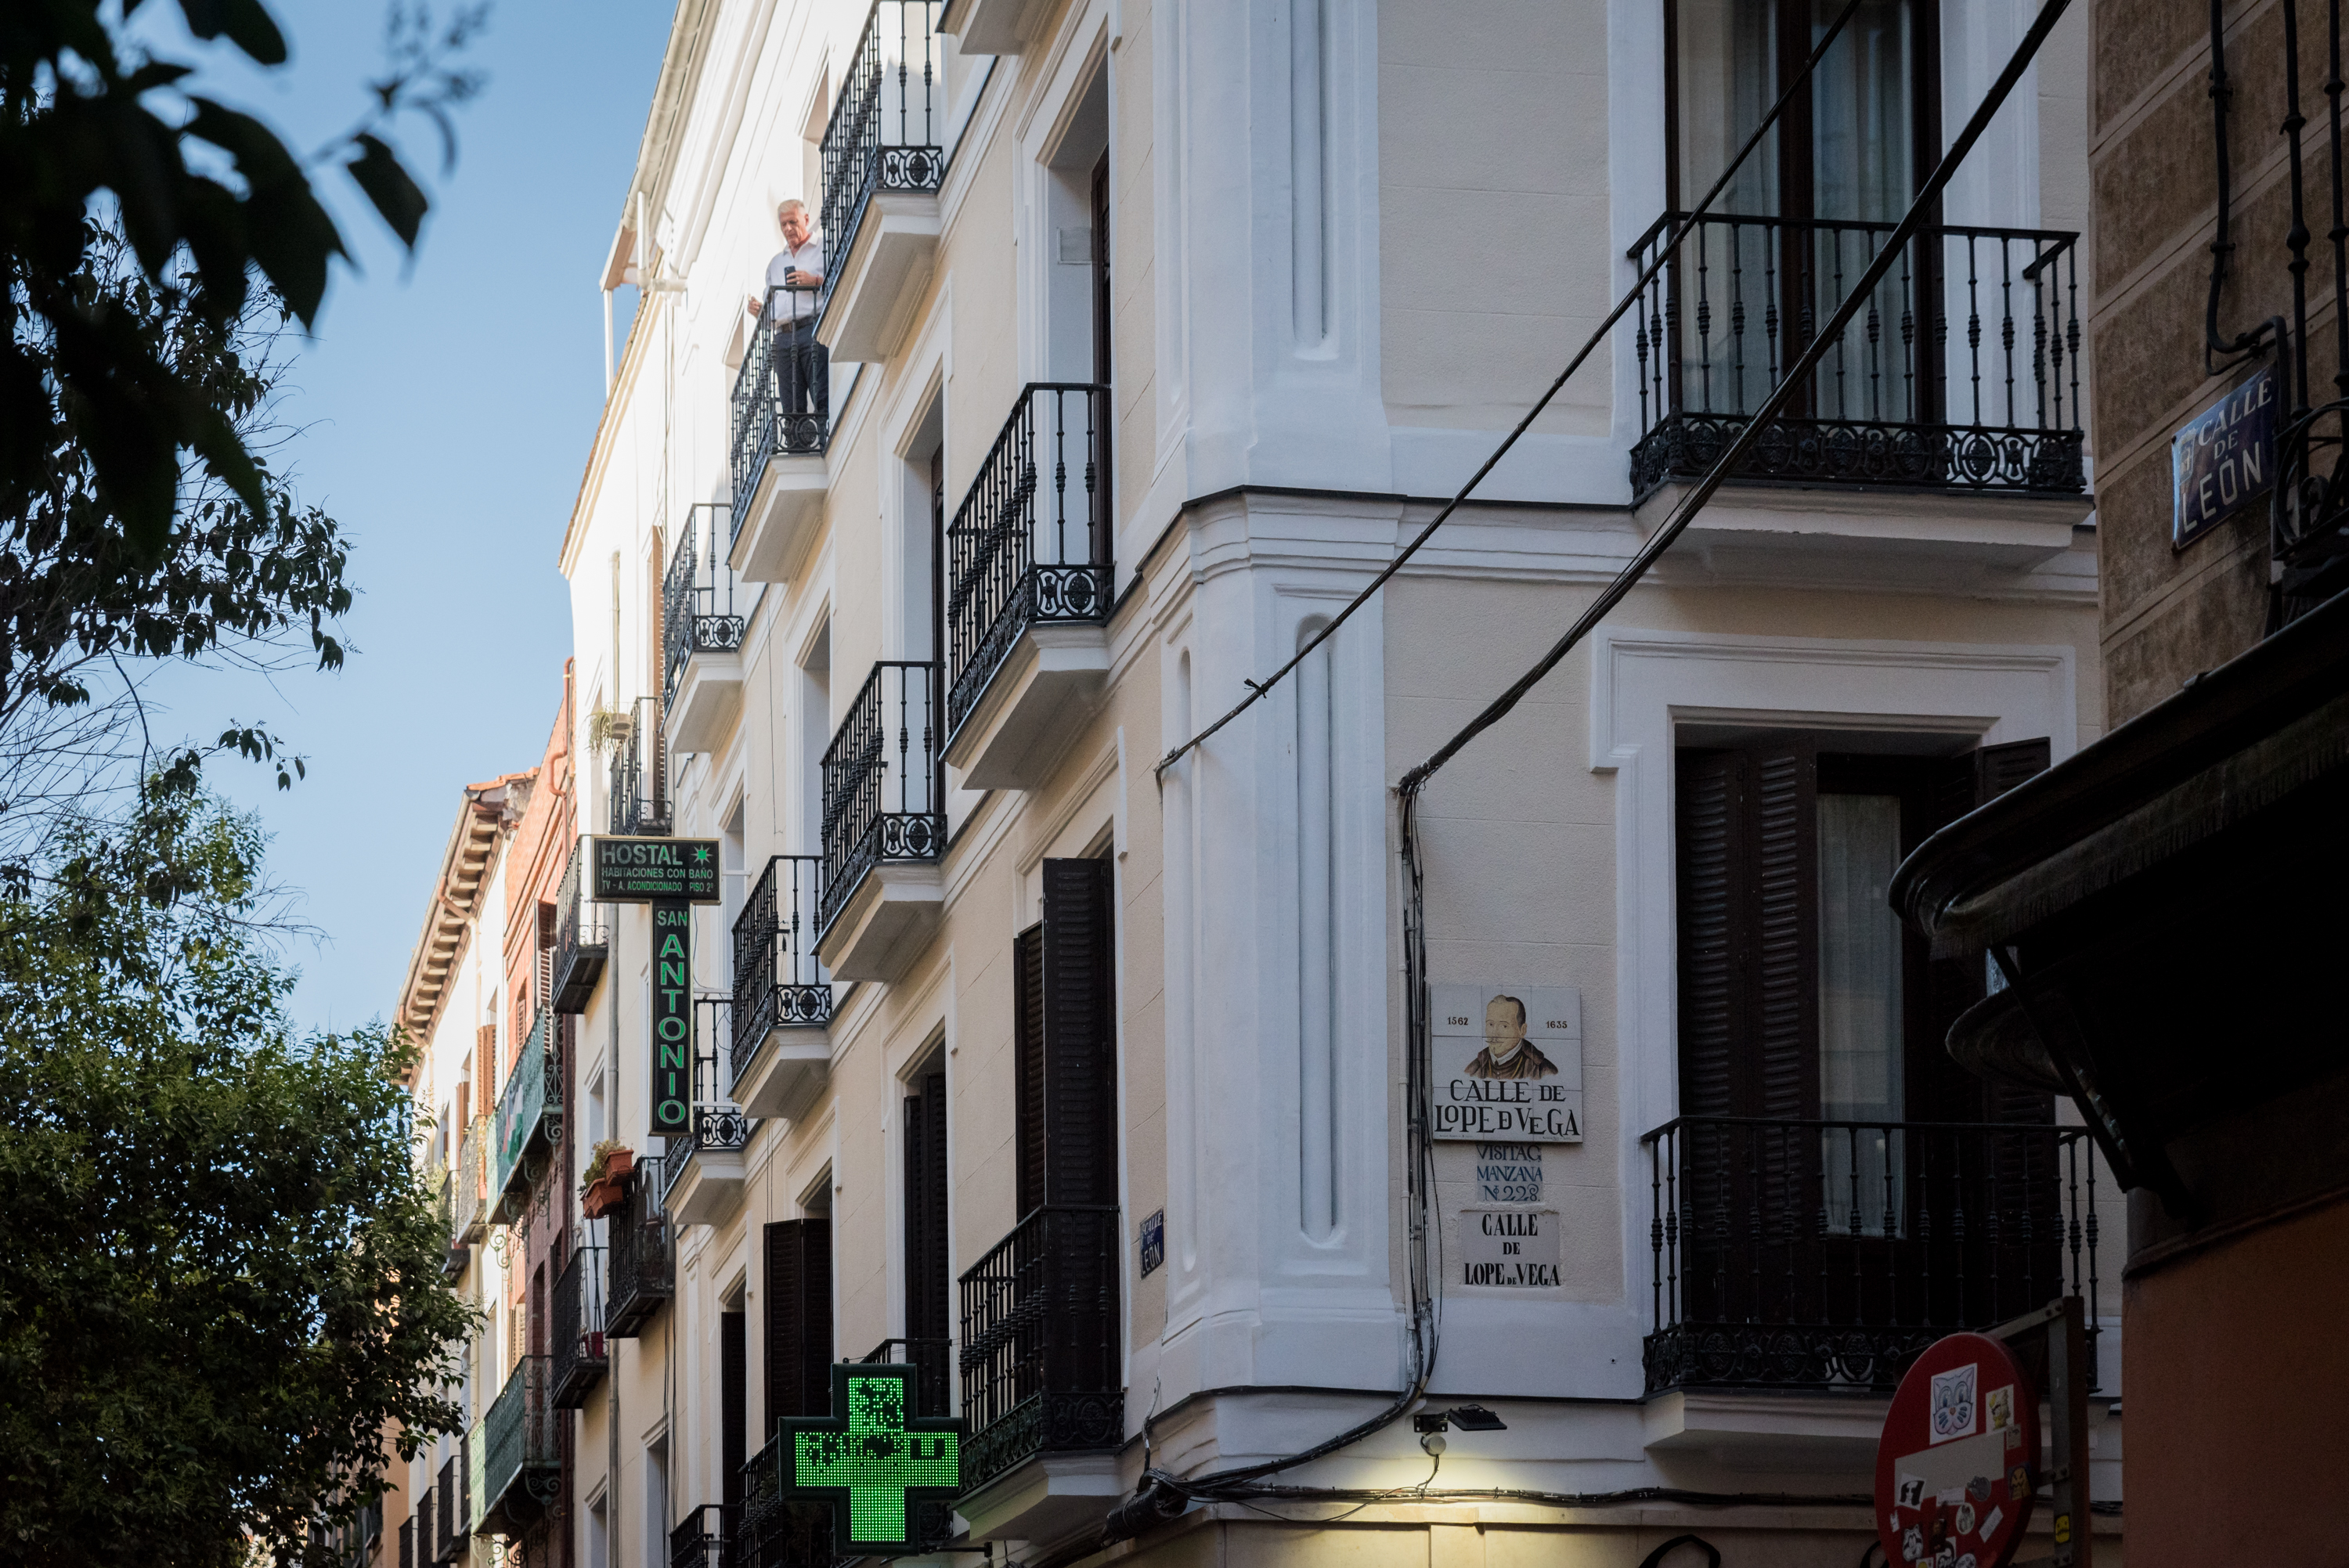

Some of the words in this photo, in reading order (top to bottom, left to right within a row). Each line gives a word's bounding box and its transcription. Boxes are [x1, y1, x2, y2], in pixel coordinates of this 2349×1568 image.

[2198, 377, 2271, 447] CALLE
[2214, 431, 2239, 460] DE
[602, 844, 684, 866] HOSTAL
[601, 867, 664, 878] HABITACIONES
[667, 868, 686, 879] CON
[689, 867, 713, 879] BAÑO
[602, 880, 611, 891] TV
[627, 881, 683, 892] ACONDICIONADO
[689, 882, 705, 892] PISO
[657, 910, 688, 927] SAN
[658, 933, 687, 1125] ANTONIO
[1447, 1016, 1469, 1026] 1562
[1546, 1020, 1568, 1029] 1635
[1449, 1079, 1532, 1104] CALLE
[1539, 1084, 1567, 1102] DE
[1434, 1105, 1496, 1134] LOPE
[1514, 1107, 1581, 1137] VEGA
[1477, 1165, 1543, 1182] MANZANA
[1144, 1212, 1163, 1235] CALLE
[1481, 1213, 1539, 1237] CALLE
[1147, 1233, 1154, 1245] DE
[1503, 1242, 1521, 1255] DE
[1464, 1263, 1505, 1286] LOPE
[1506, 1276, 1517, 1285] DE
[1515, 1263, 1561, 1286] VEGA
